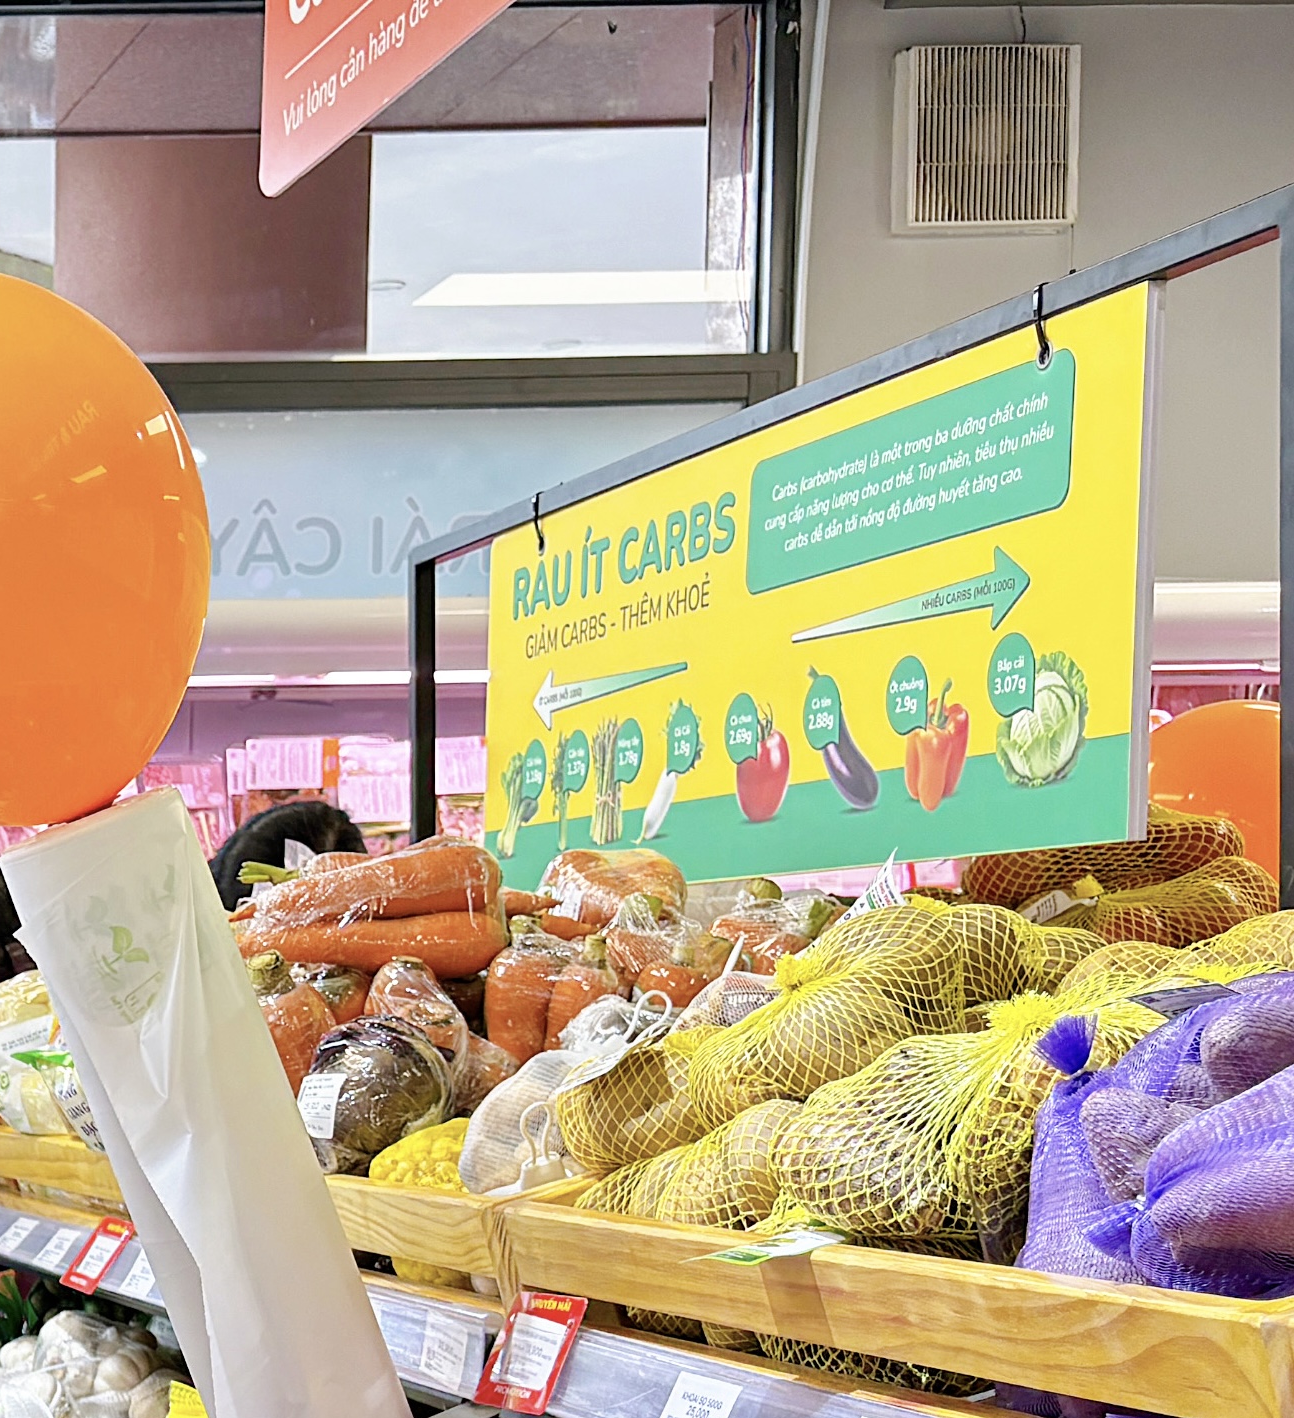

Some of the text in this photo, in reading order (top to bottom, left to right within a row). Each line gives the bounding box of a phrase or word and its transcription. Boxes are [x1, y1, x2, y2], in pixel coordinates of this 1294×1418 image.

[282, 20, 406, 136] Vui lòng cân hàng
[772, 392, 1049, 502] Carbs (carbohydrate) là một trong ba dưỡng chất chính
[765, 514, 787, 532] cung
[788, 502, 805, 526] cấp
[806, 497, 831, 521] năng
[832, 487, 859, 514] lượng
[861, 480, 879, 499] cho
[880, 474, 894, 493] cơ
[918, 463, 937, 482] Tuy
[939, 450, 973, 474] nhiên,
[975, 438, 998, 463] tiêu
[999, 434, 1019, 456] thụ
[1020, 421, 1055, 449] nhiều
[784, 466, 1024, 553] carbs dễ dẫn tới nồng độ đường huyết tăng cao.
[580, 525, 611, 599] ÍT
[618, 491, 737, 585] CARBS
[525, 623, 559, 659] GIẢM
[561, 612, 607, 649] CARBS
[620, 591, 662, 632] THÊM
[665, 572, 711, 620] KHOẺ
[945, 587, 972, 607] CARBS
[993, 577, 1016, 597] 100G)
[895, 697, 917, 715] 2.9g
[993, 677, 1027, 695] 3.07g
[674, 741, 691, 757] 1.8g
[729, 727, 751, 745] 2.69g
[808, 713, 834, 730] 2.88g
